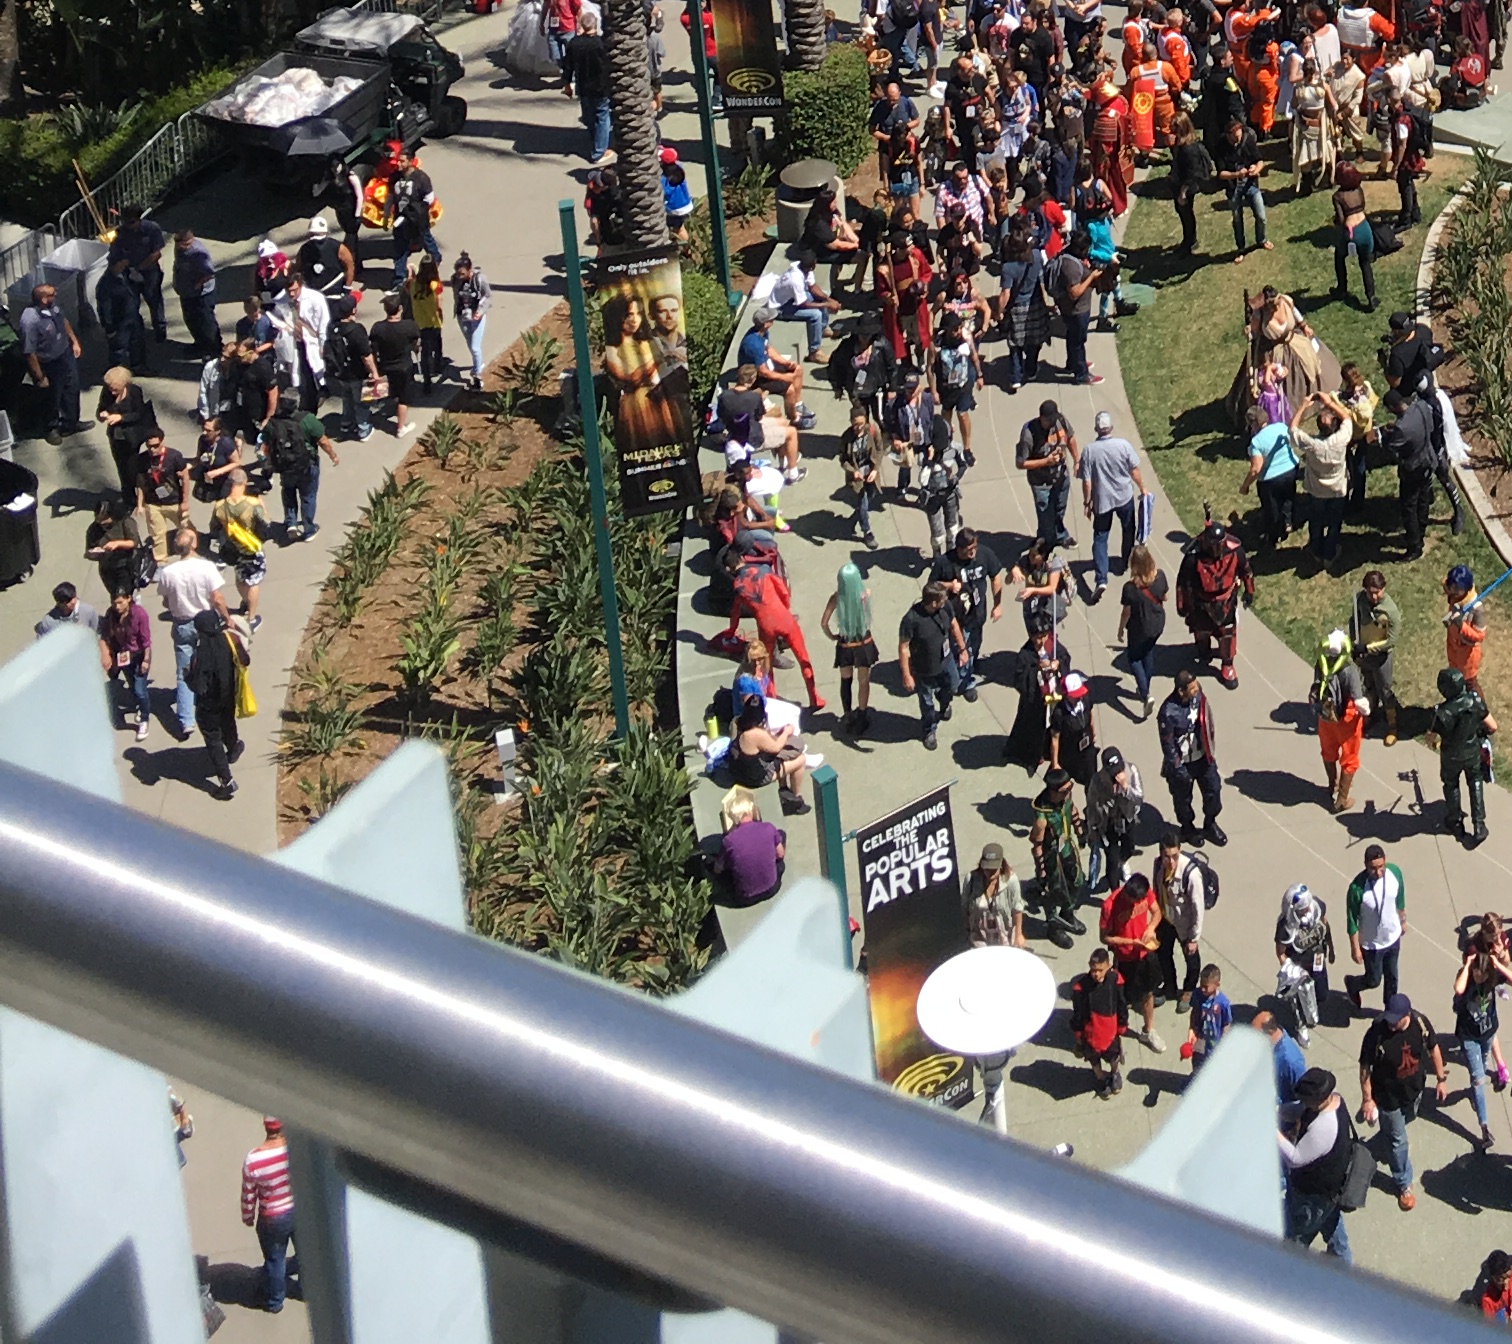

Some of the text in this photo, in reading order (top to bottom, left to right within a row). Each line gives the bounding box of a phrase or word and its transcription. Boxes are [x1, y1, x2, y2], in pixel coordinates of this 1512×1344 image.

[862, 801, 947, 853] CELEBRATING
[892, 829, 919, 850] THE
[865, 827, 950, 883] POPULAR
[866, 846, 953, 914] ARTS
